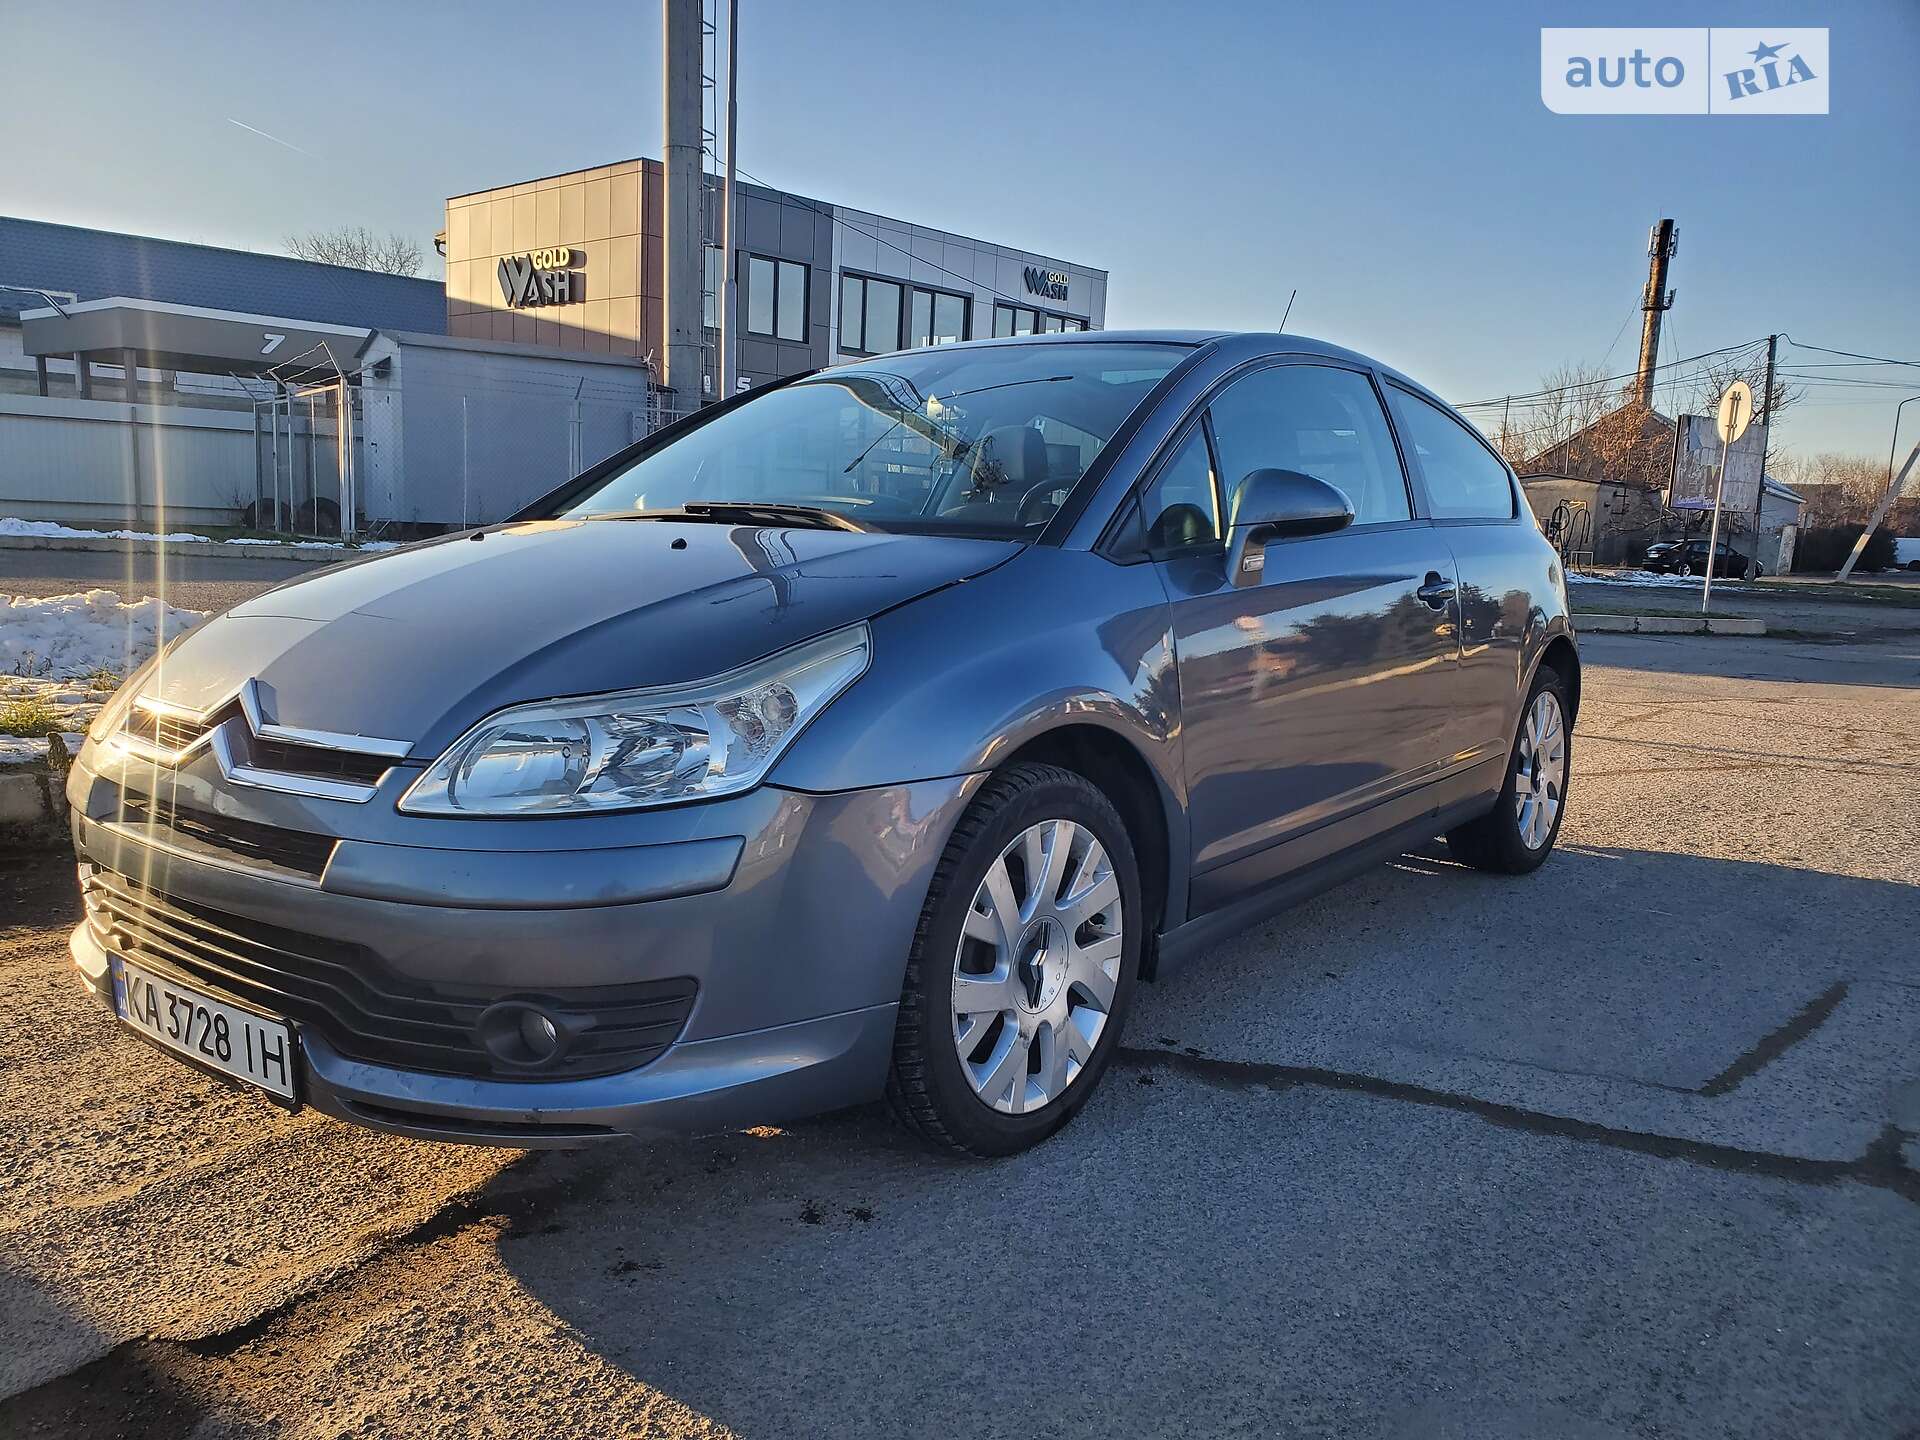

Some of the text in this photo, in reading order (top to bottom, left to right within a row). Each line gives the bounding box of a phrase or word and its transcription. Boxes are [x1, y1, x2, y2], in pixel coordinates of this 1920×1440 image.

[533, 247, 570, 270] GOLD
[498, 253, 571, 309] WASH
[1024, 266, 1069, 301] WASH
[1047, 271, 1069, 284] GOLD
[261, 333, 286, 354] 7
[124, 971, 287, 1087] KA 3728 IH
